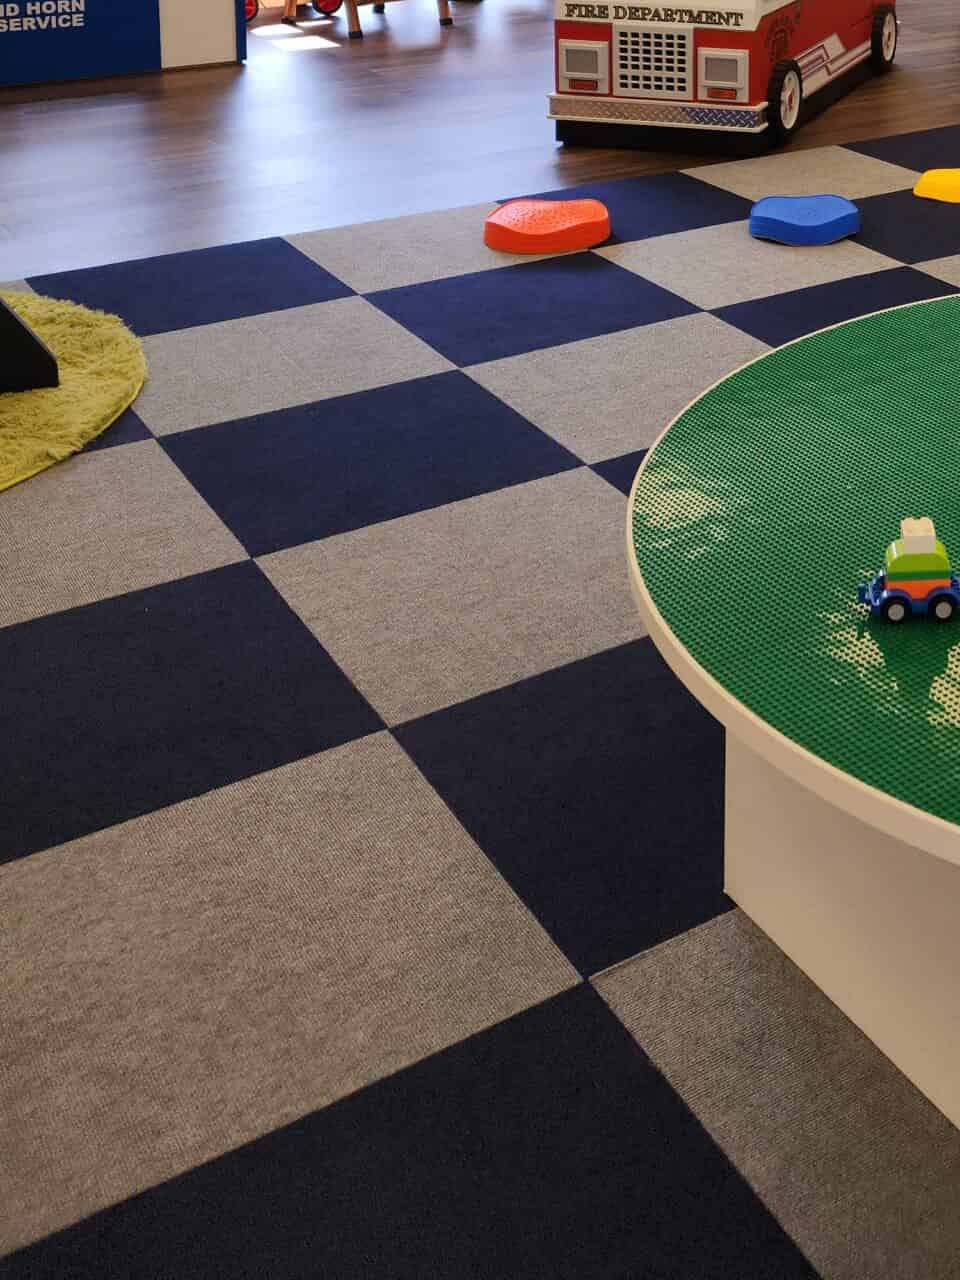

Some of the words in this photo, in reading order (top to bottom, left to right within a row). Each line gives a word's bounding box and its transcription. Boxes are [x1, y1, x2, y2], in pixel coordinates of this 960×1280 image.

[26, 0, 86, 15] HORN
[565, 3, 609, 19] FIRE
[612, 5, 743, 27] DEPARTMENT
[0, 13, 85, 33] SERVICE
